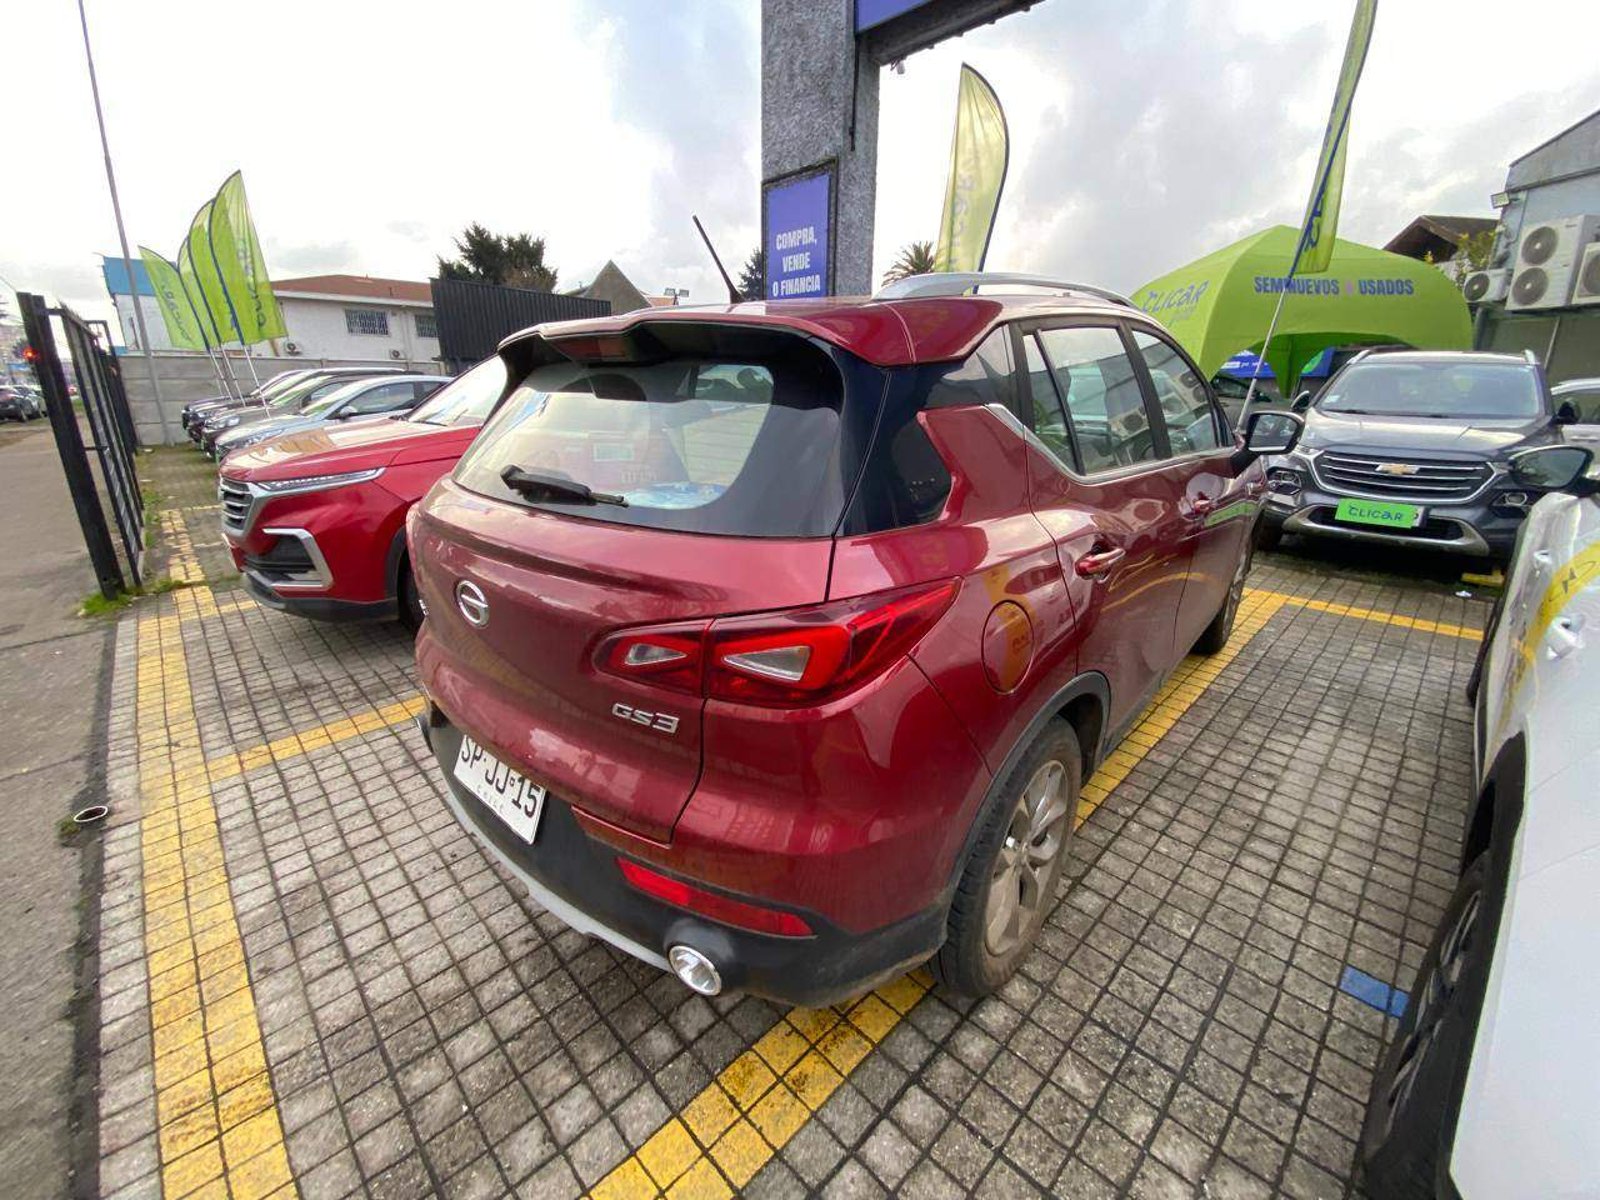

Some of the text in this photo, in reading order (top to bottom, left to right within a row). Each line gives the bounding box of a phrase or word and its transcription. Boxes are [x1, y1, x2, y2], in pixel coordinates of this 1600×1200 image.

[776, 226, 817, 250] COMPRA,
[782, 252, 811, 272] VENDE
[772, 274, 821, 297] O FINANCIA
[1254, 276, 1340, 296] SEMNUEVOS
[1358, 279, 1414, 296] USADOS
[611, 703, 680, 733] GS3
